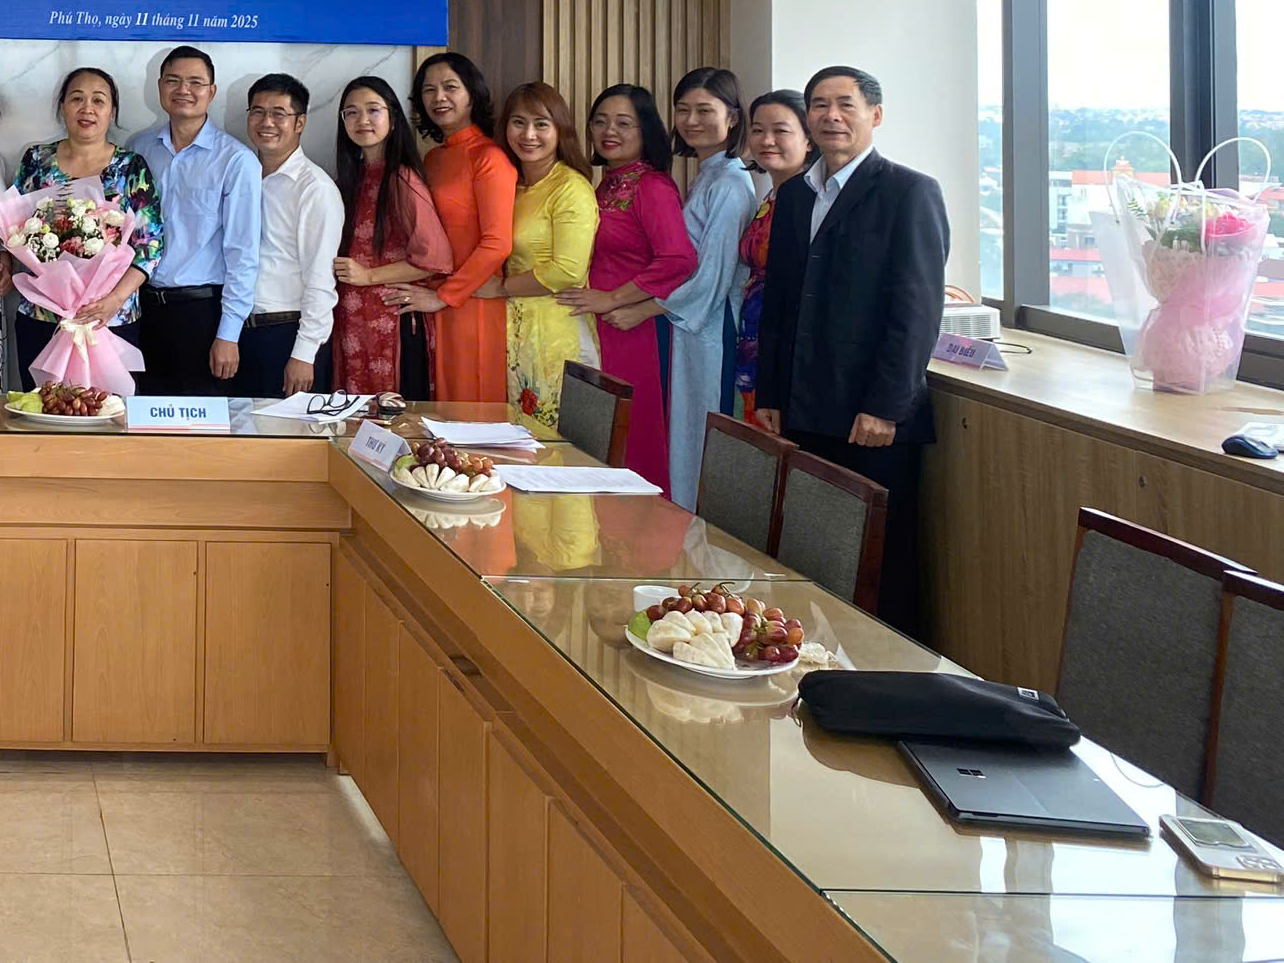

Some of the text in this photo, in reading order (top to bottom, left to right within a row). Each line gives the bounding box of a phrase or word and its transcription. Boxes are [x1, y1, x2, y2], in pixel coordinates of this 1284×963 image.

[49, 11, 258, 29] Phú Thọ, ngày 11 tháng 11 năm 2025
[149, 403, 207, 421] CHỦ TỊCH
